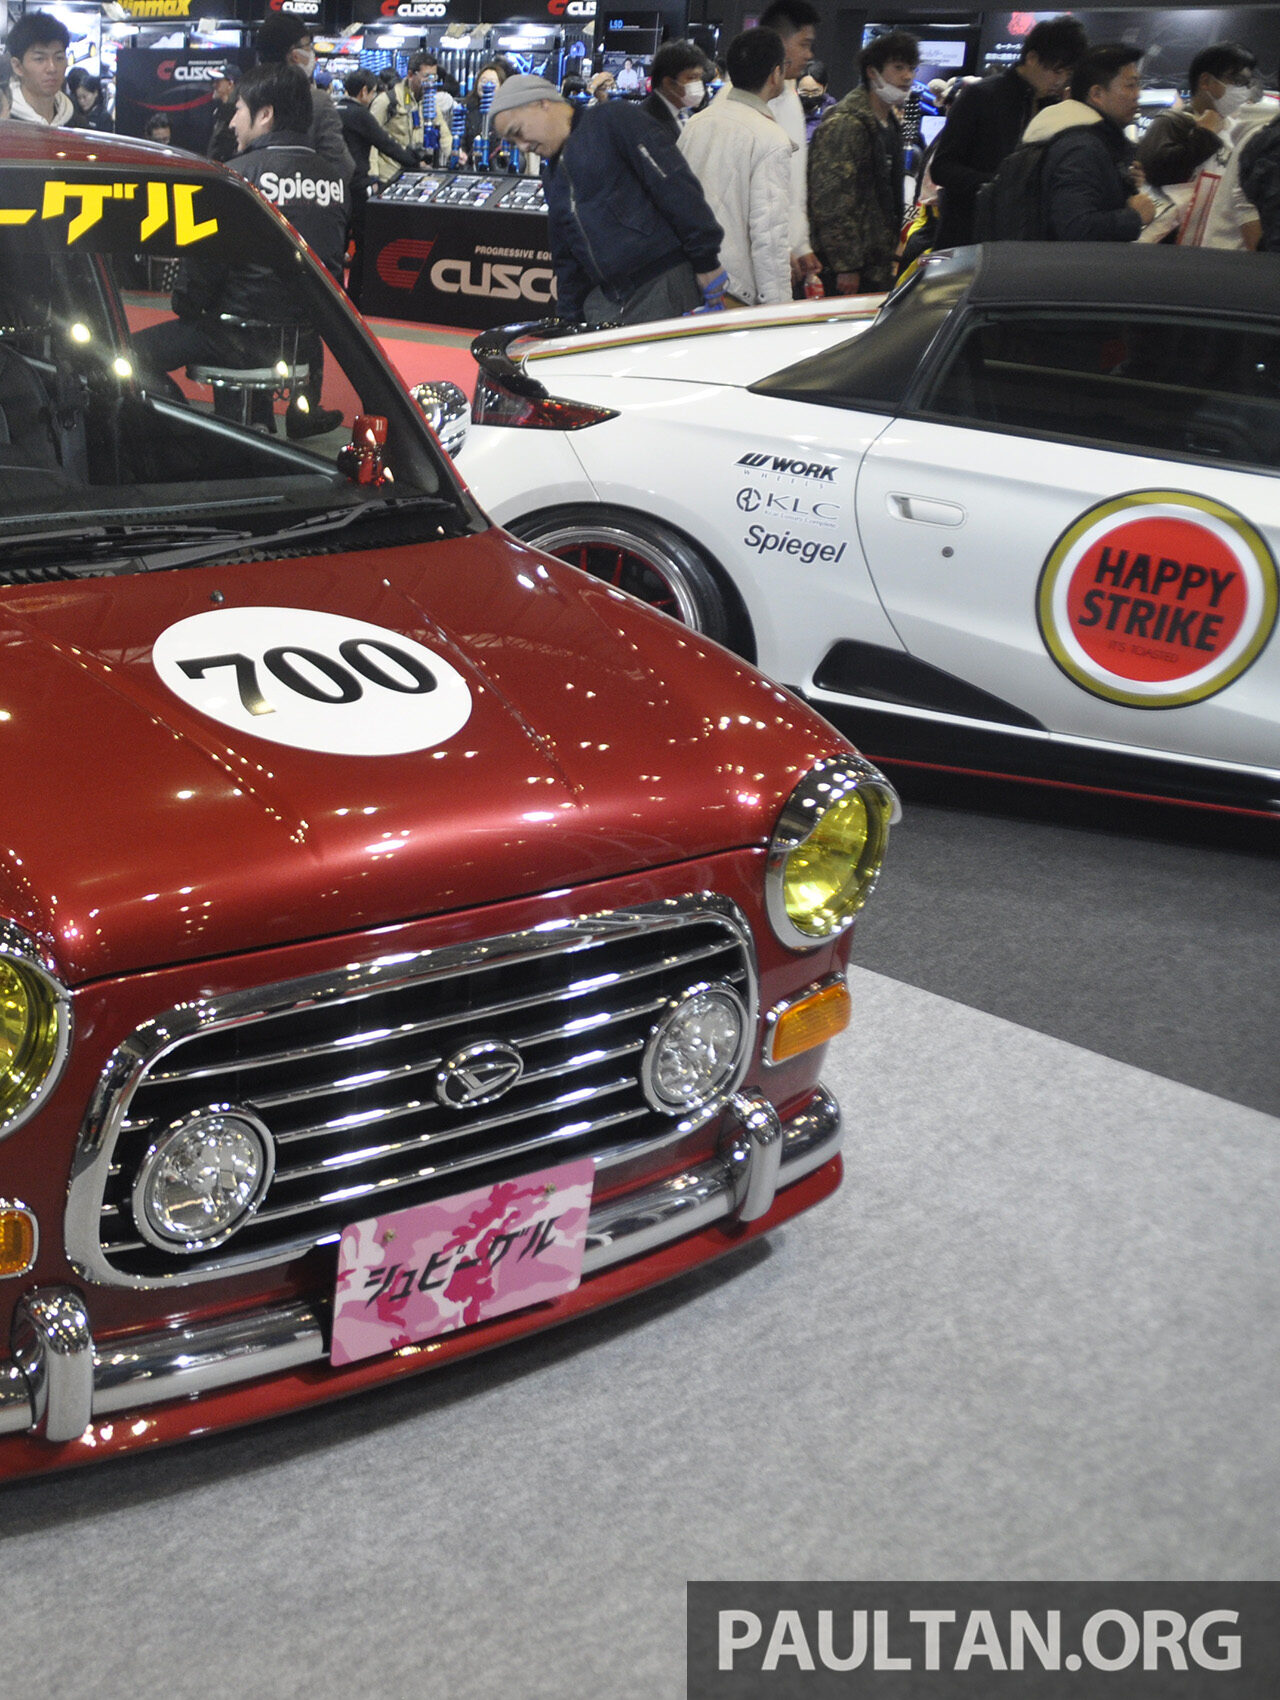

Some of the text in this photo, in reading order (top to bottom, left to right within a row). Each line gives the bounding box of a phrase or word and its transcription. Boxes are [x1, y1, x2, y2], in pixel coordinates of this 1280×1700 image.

[397, 4, 447, 17] CUSCO
[260, 172, 344, 206] Spiegel
[474, 245, 534, 259] PROGRESSIVE
[772, 457, 839, 481] WORK
[766, 493, 841, 520] KLC
[744, 525, 847, 563] Spiegel
[1094, 546, 1237, 608] HAPPY
[1078, 589, 1224, 652] STRIKE
[175, 638, 438, 716] 700
[363, 1215, 563, 1310] シュピーゲル
